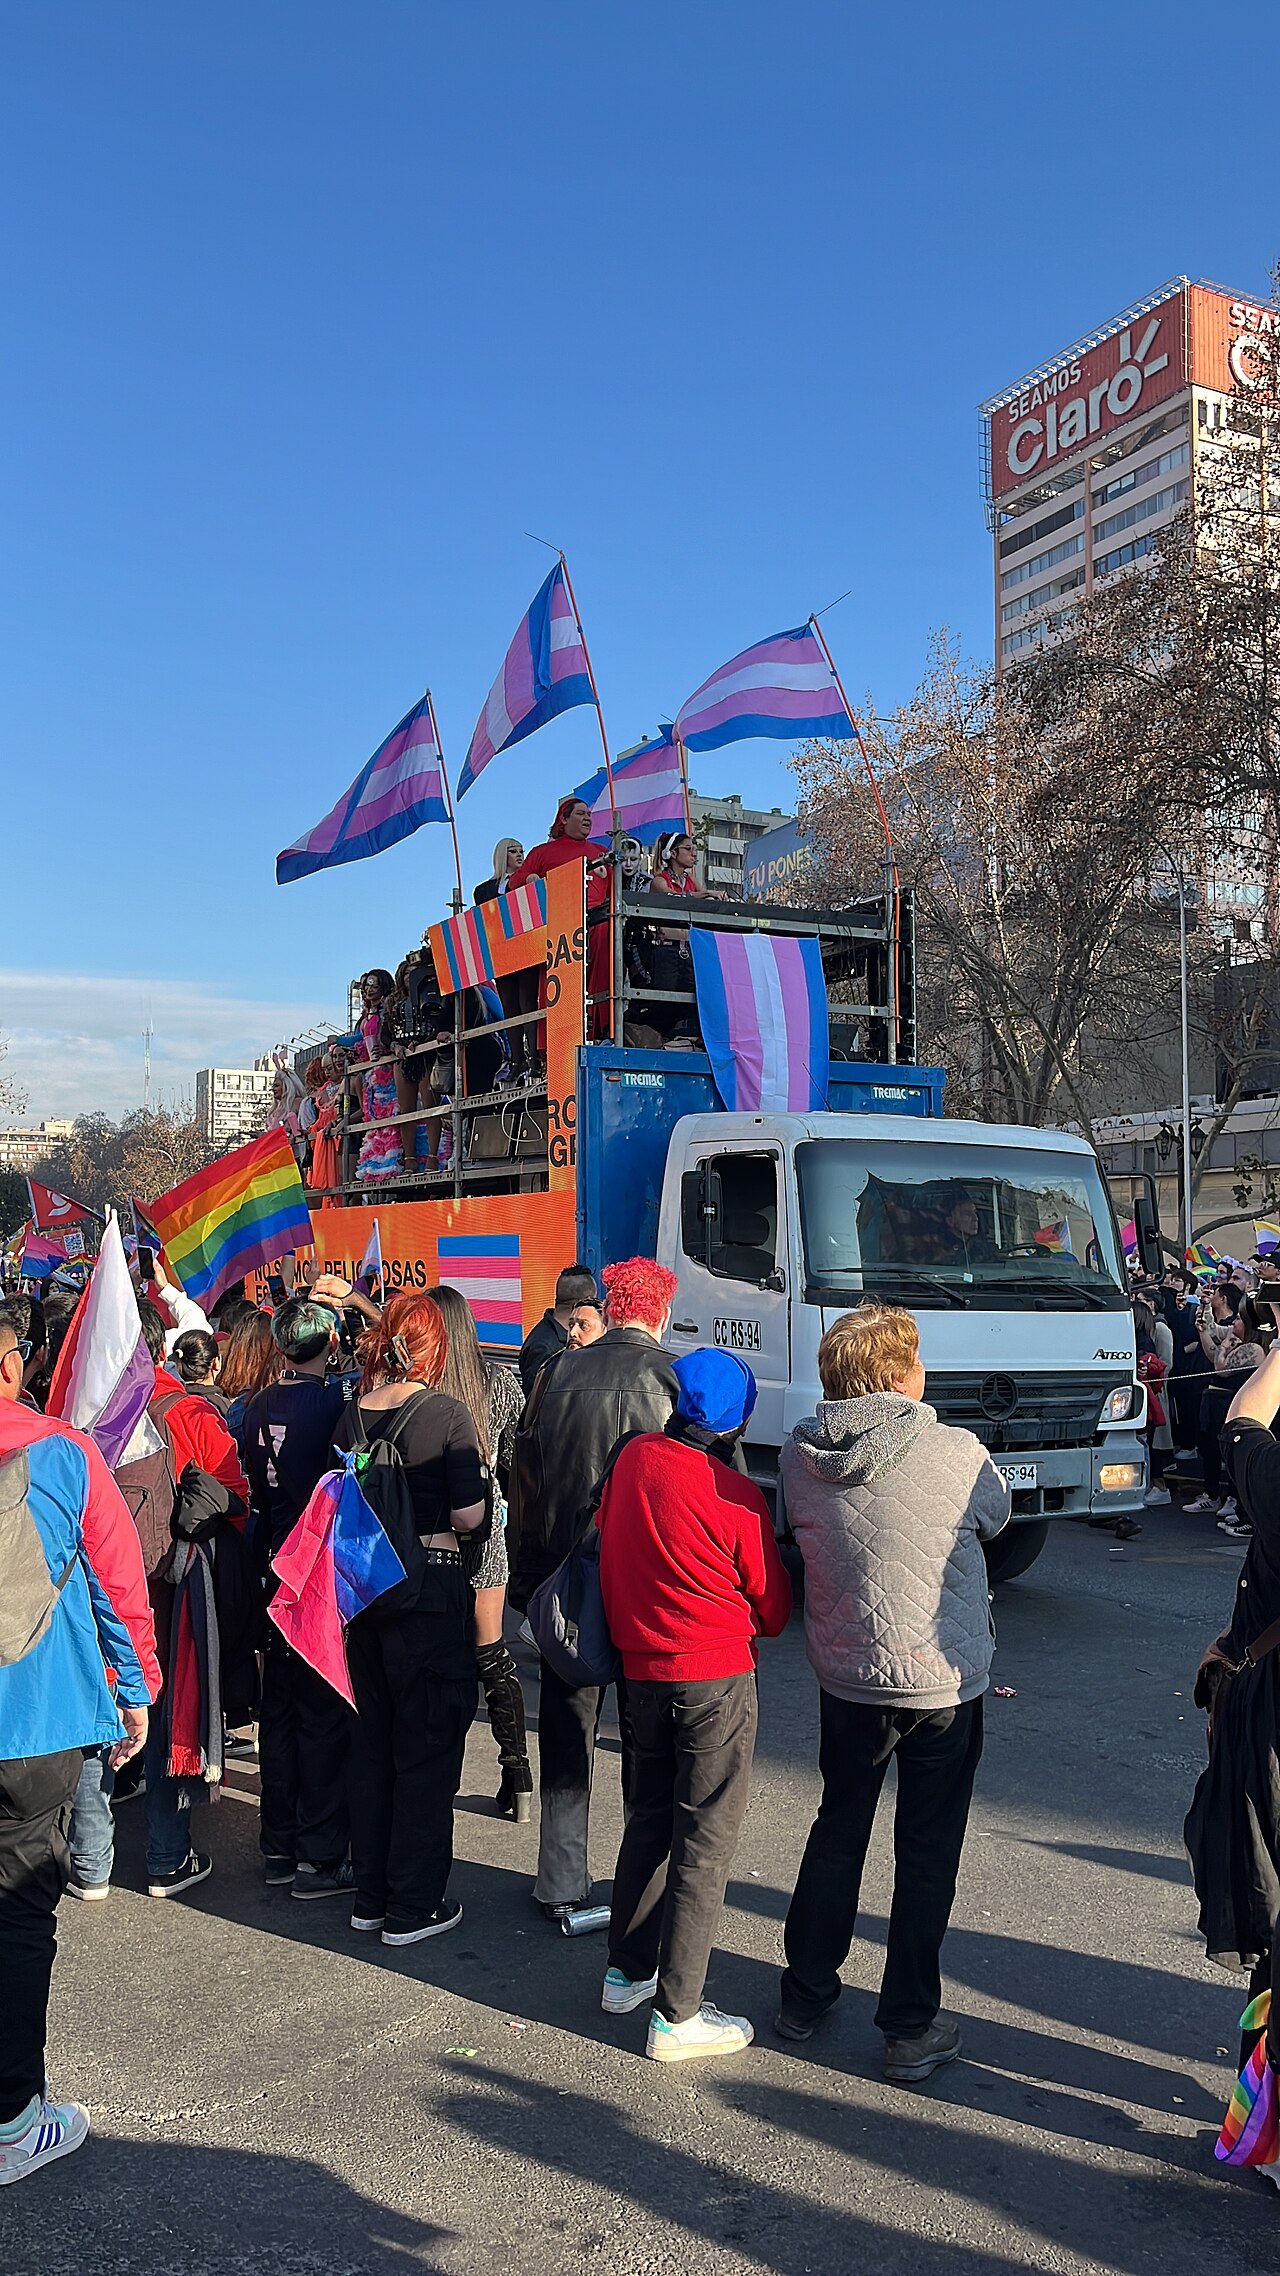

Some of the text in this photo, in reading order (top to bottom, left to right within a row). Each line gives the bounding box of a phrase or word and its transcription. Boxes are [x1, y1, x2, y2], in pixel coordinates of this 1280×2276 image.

[1008, 361, 1082, 424] SEAMOS
[1007, 364, 1143, 476] Claro
[748, 861, 766, 889] TÚ
[624, 1073, 663, 1087] TREMAC
[873, 1086, 907, 1100] TREMAC
[715, 1319, 728, 1346] CC
